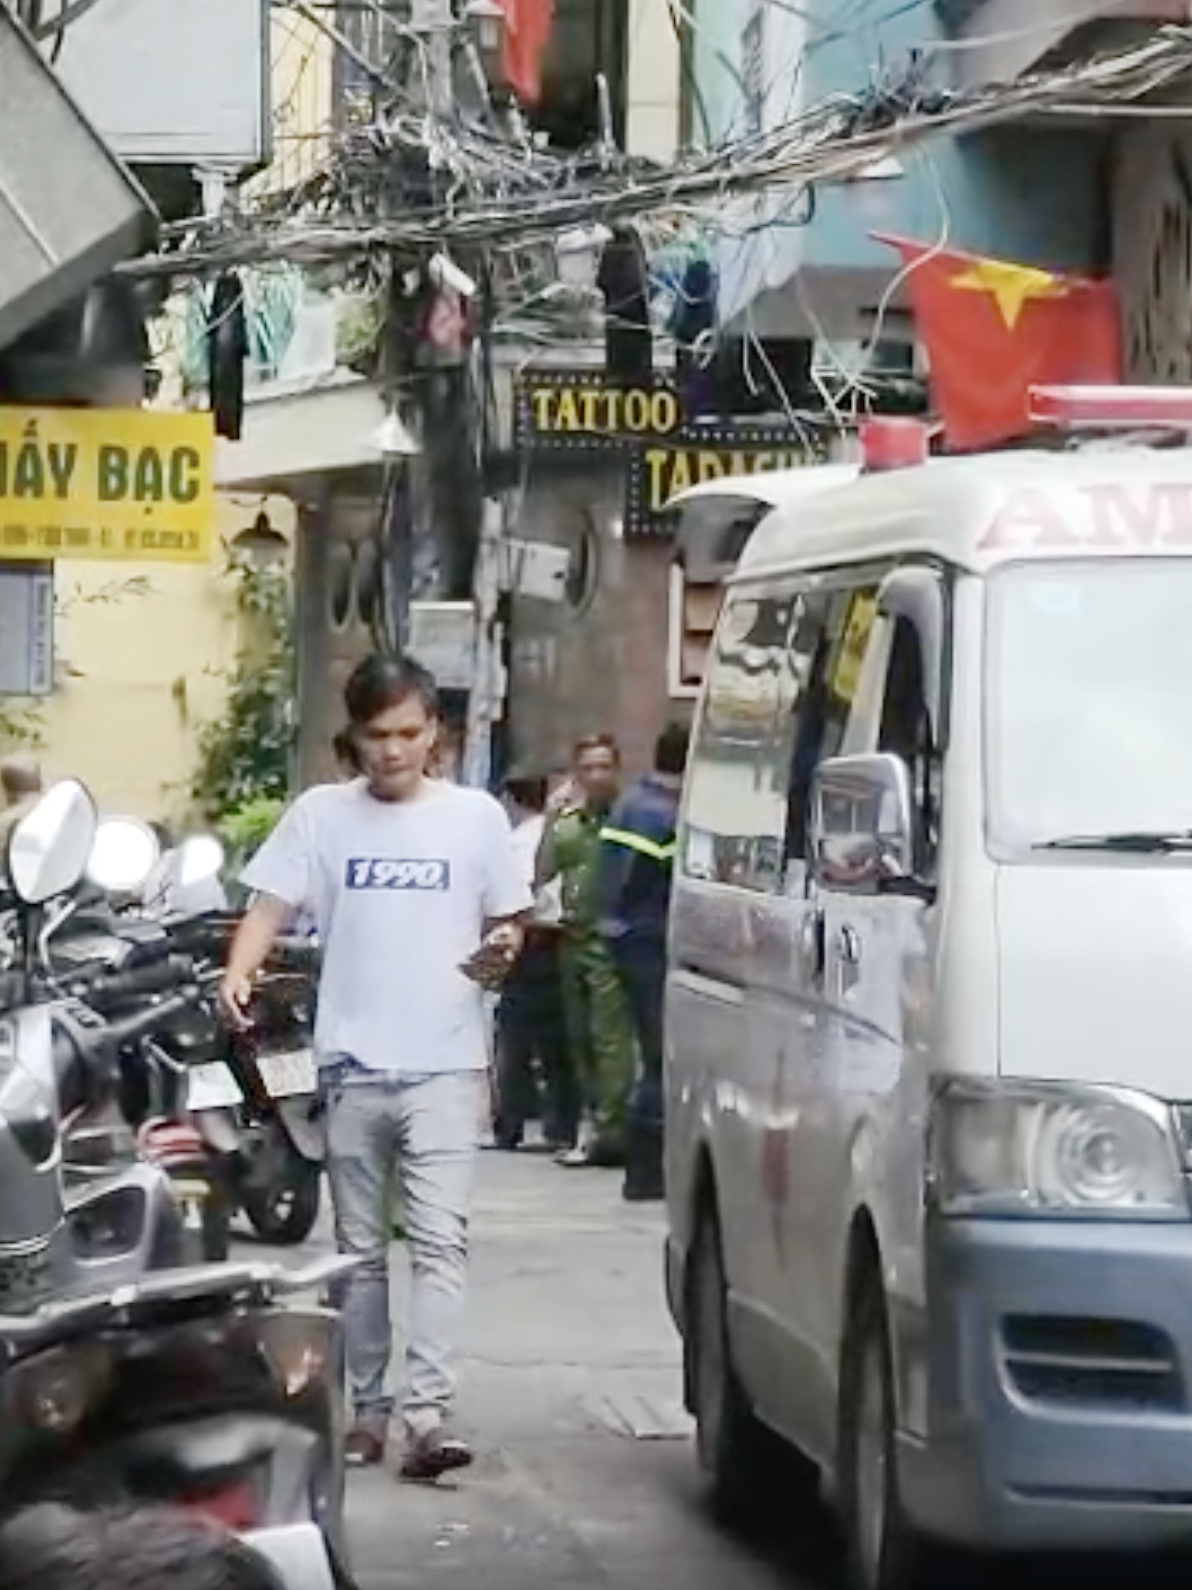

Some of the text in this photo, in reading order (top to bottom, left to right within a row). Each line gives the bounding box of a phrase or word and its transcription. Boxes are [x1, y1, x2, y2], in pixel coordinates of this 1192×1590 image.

[532, 388, 678, 433] TATTOO
[0, 418, 200, 516] ẤY BẠC
